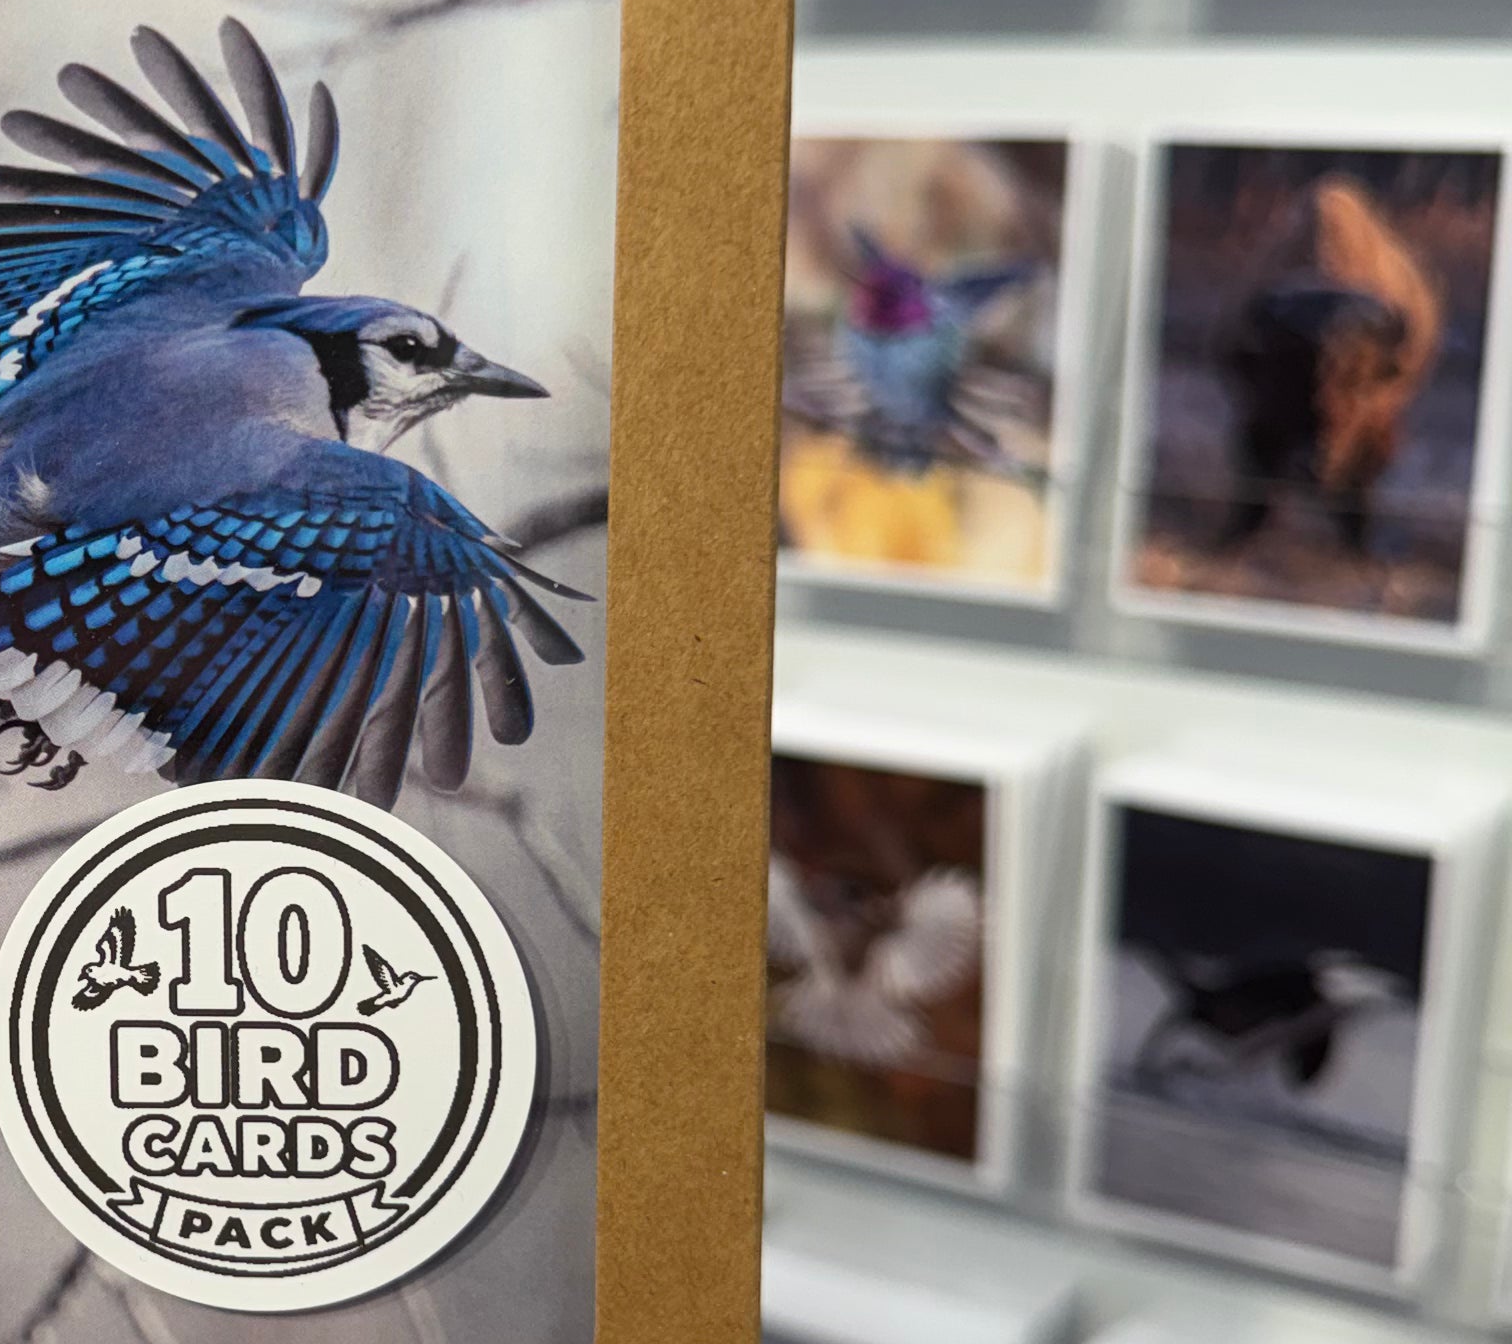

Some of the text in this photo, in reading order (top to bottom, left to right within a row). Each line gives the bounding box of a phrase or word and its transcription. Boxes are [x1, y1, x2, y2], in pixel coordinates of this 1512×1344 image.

[159, 867, 352, 1019] 10
[112, 1021, 399, 1110] BIRD
[124, 1115, 397, 1177] CARDS
[178, 1210, 339, 1250] PACK
